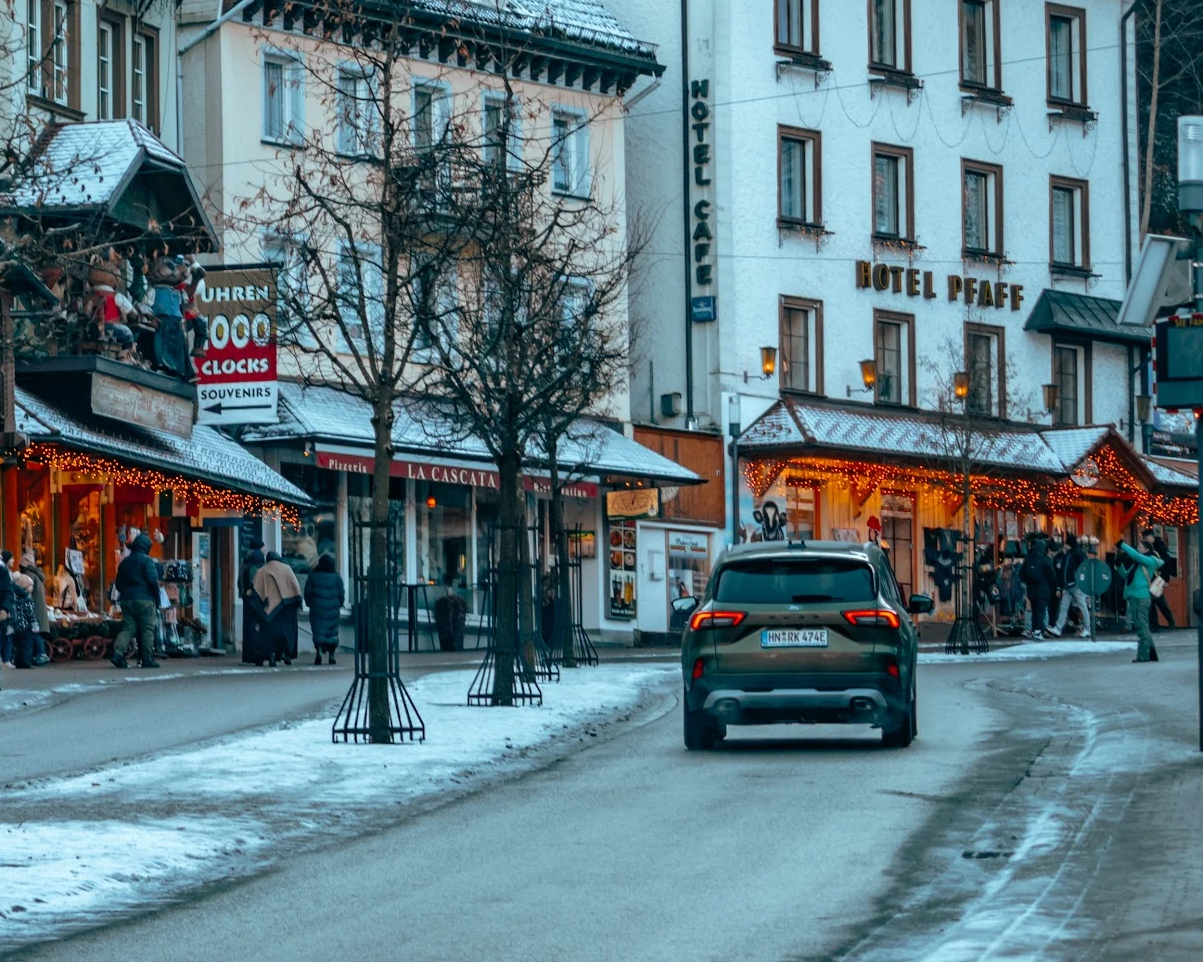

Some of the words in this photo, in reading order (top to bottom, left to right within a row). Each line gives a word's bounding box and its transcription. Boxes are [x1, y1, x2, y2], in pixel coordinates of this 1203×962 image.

[691, 79, 711, 186] HOTEL
[693, 199, 713, 286] CAFE
[200, 285, 270, 303] UHREN
[855, 260, 936, 300] HOTEL
[947, 275, 1024, 312] PFAFF
[201, 358, 269, 376] CLOCKS
[200, 387, 271, 400] SOUVENIRS
[328, 458, 367, 473] Pizzeria
[407, 464, 427, 480] LA
[431, 465, 496, 488] CASCATA
[533, 481, 587, 498] Ristantino
[768, 632, 781, 642] HN
[788, 631, 800, 642] RK
[802, 631, 826, 642] 474E
